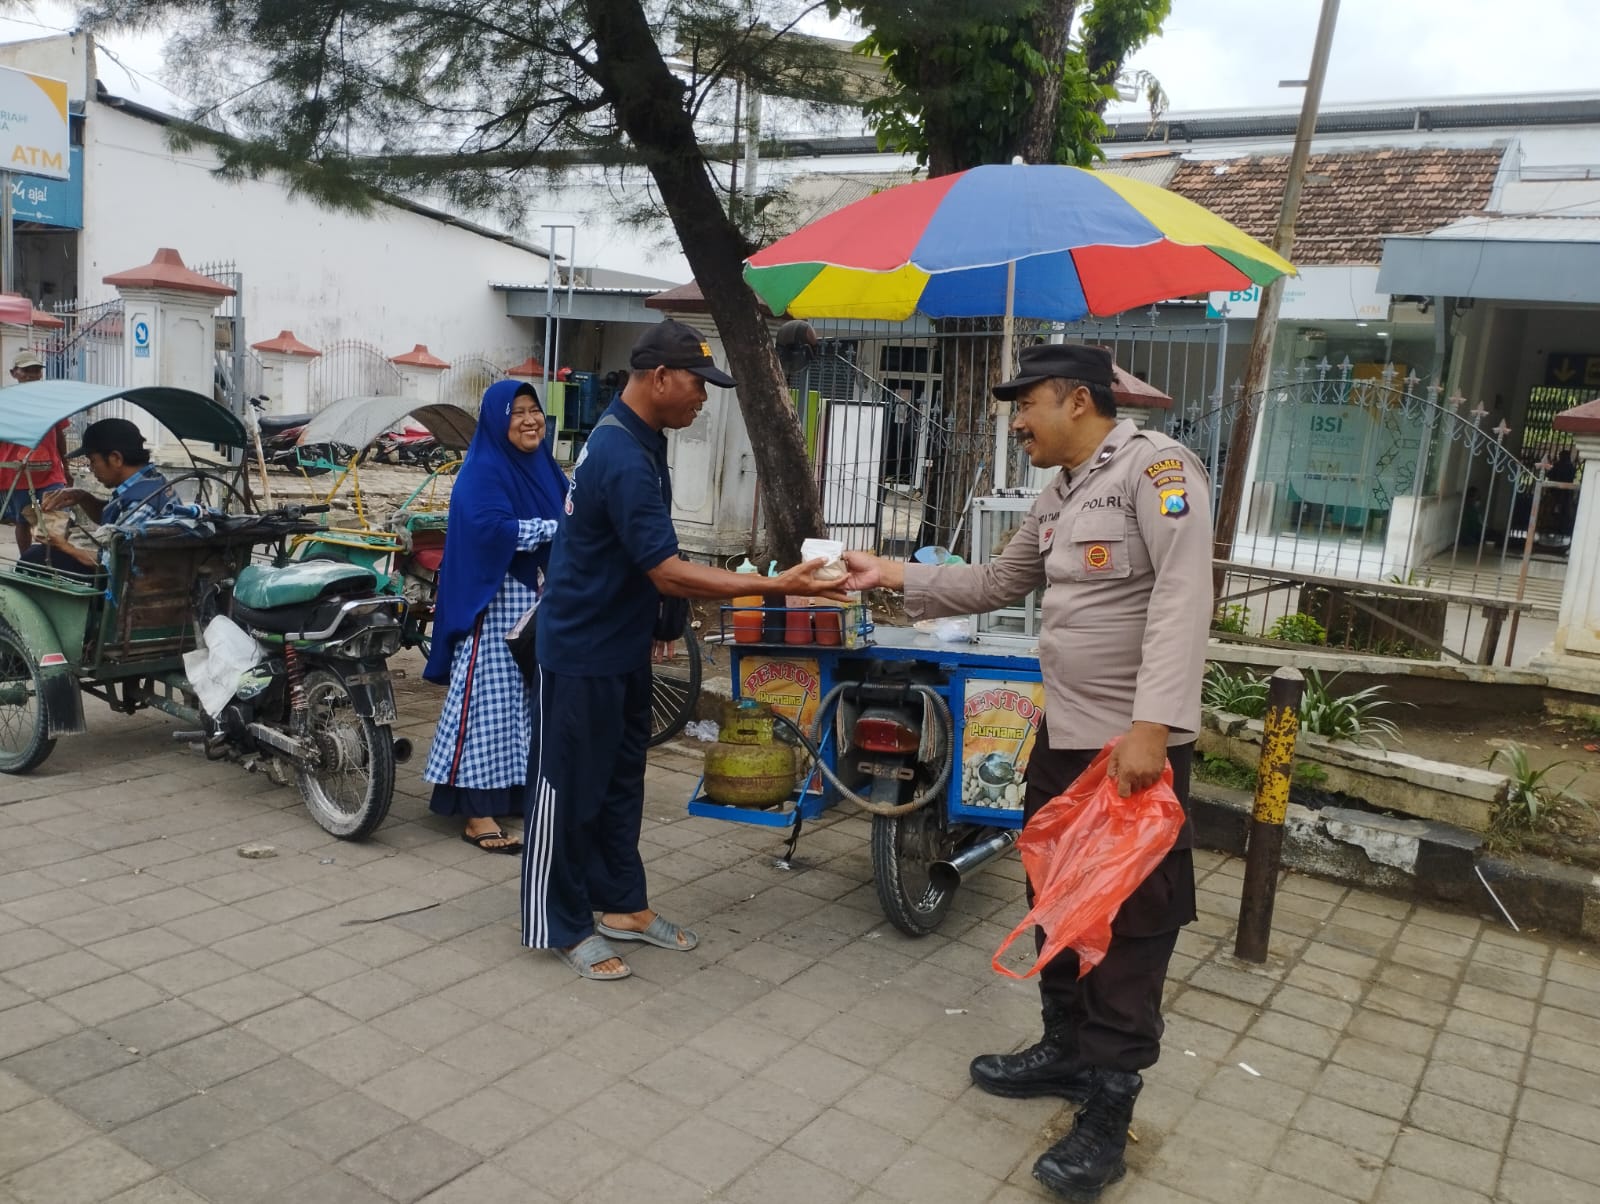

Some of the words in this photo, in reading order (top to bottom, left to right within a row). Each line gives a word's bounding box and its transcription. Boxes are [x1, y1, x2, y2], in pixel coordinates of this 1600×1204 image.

[11, 144, 63, 170] ATM
[1229, 287, 1259, 302] BSI
[1310, 416, 1343, 433] BSI
[1148, 460, 1181, 473] POLRES
[1081, 496, 1121, 511] POLRI
[744, 662, 818, 700] PENTOL
[760, 691, 803, 706] Purnama
[971, 722, 1025, 740] Purnama
